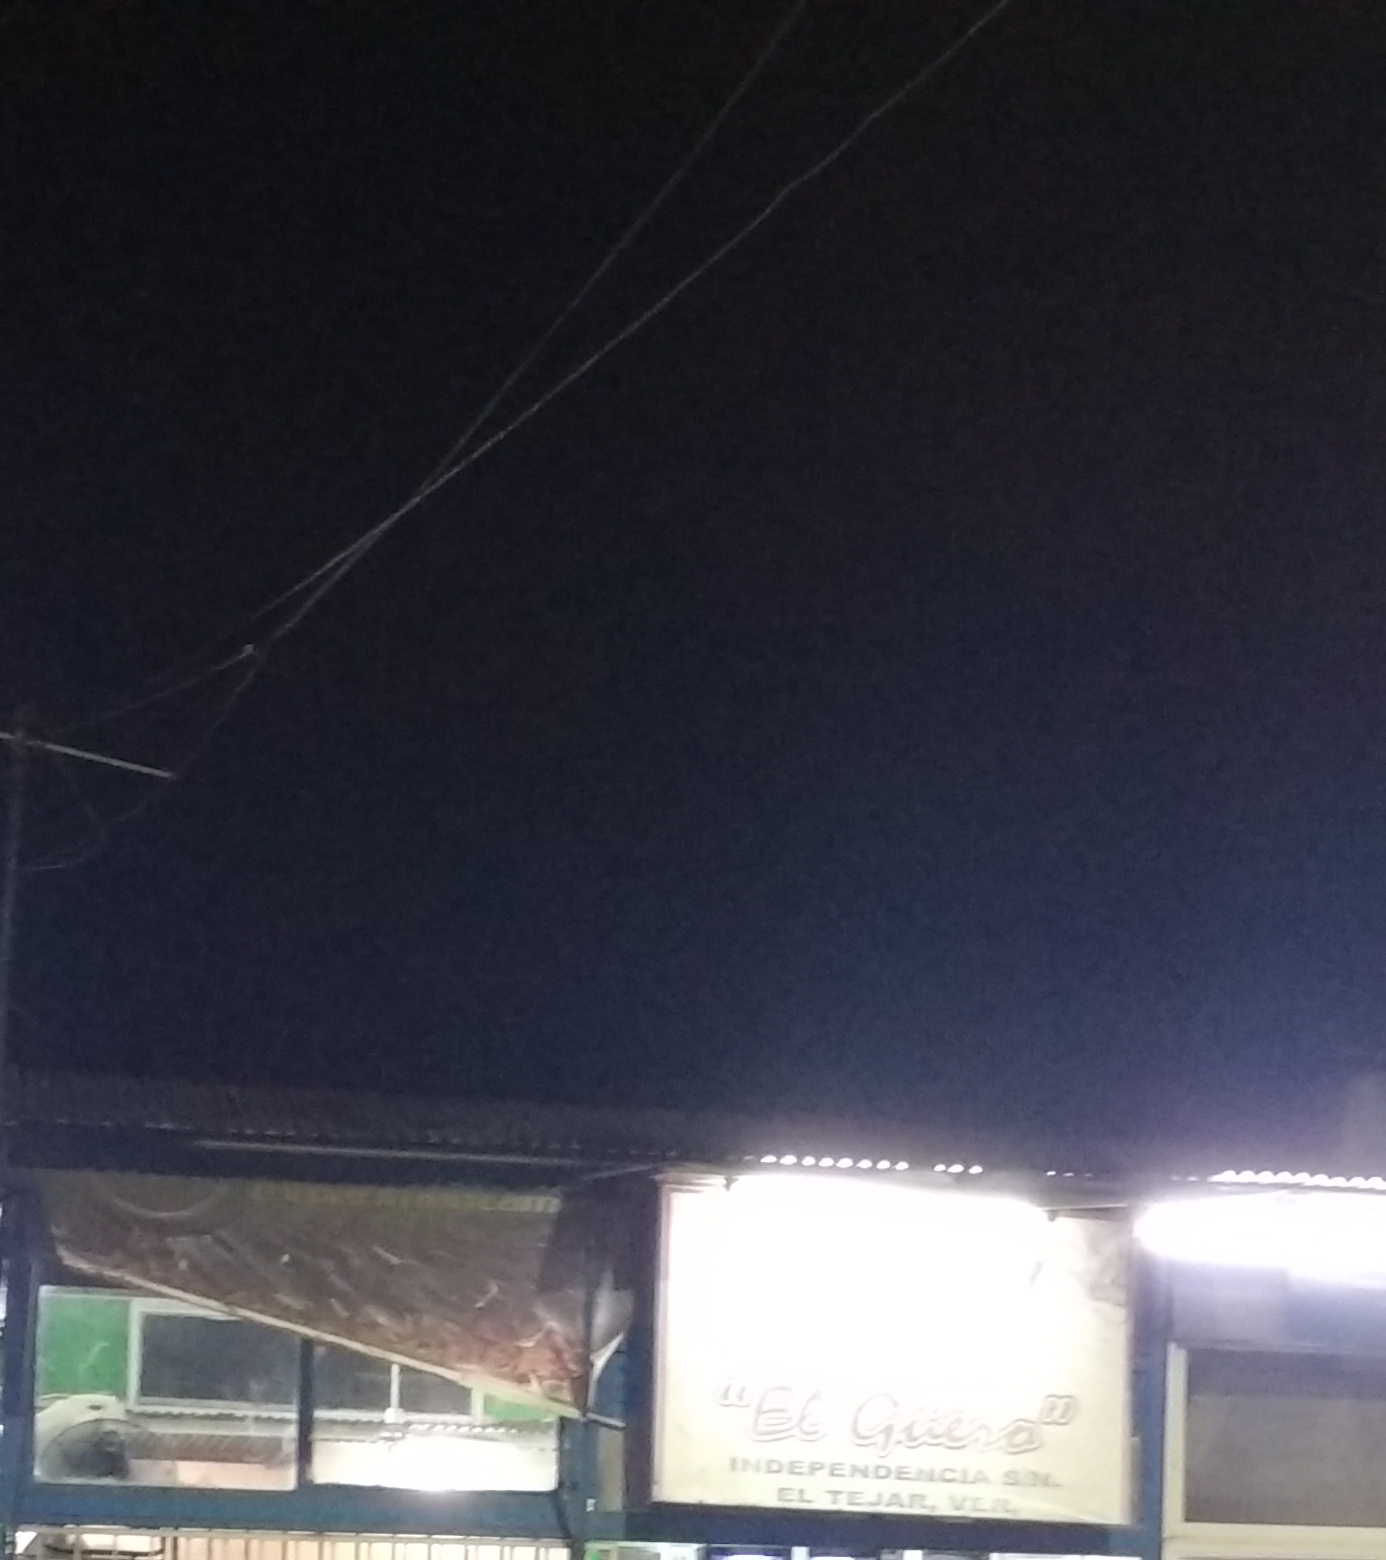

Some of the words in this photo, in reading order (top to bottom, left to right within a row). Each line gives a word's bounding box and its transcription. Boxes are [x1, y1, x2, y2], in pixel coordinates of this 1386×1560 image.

[728, 1456, 989, 1484] INDEPENDENCIA
[776, 1487, 815, 1504] EL
[824, 1489, 936, 1512] TEJAR,
